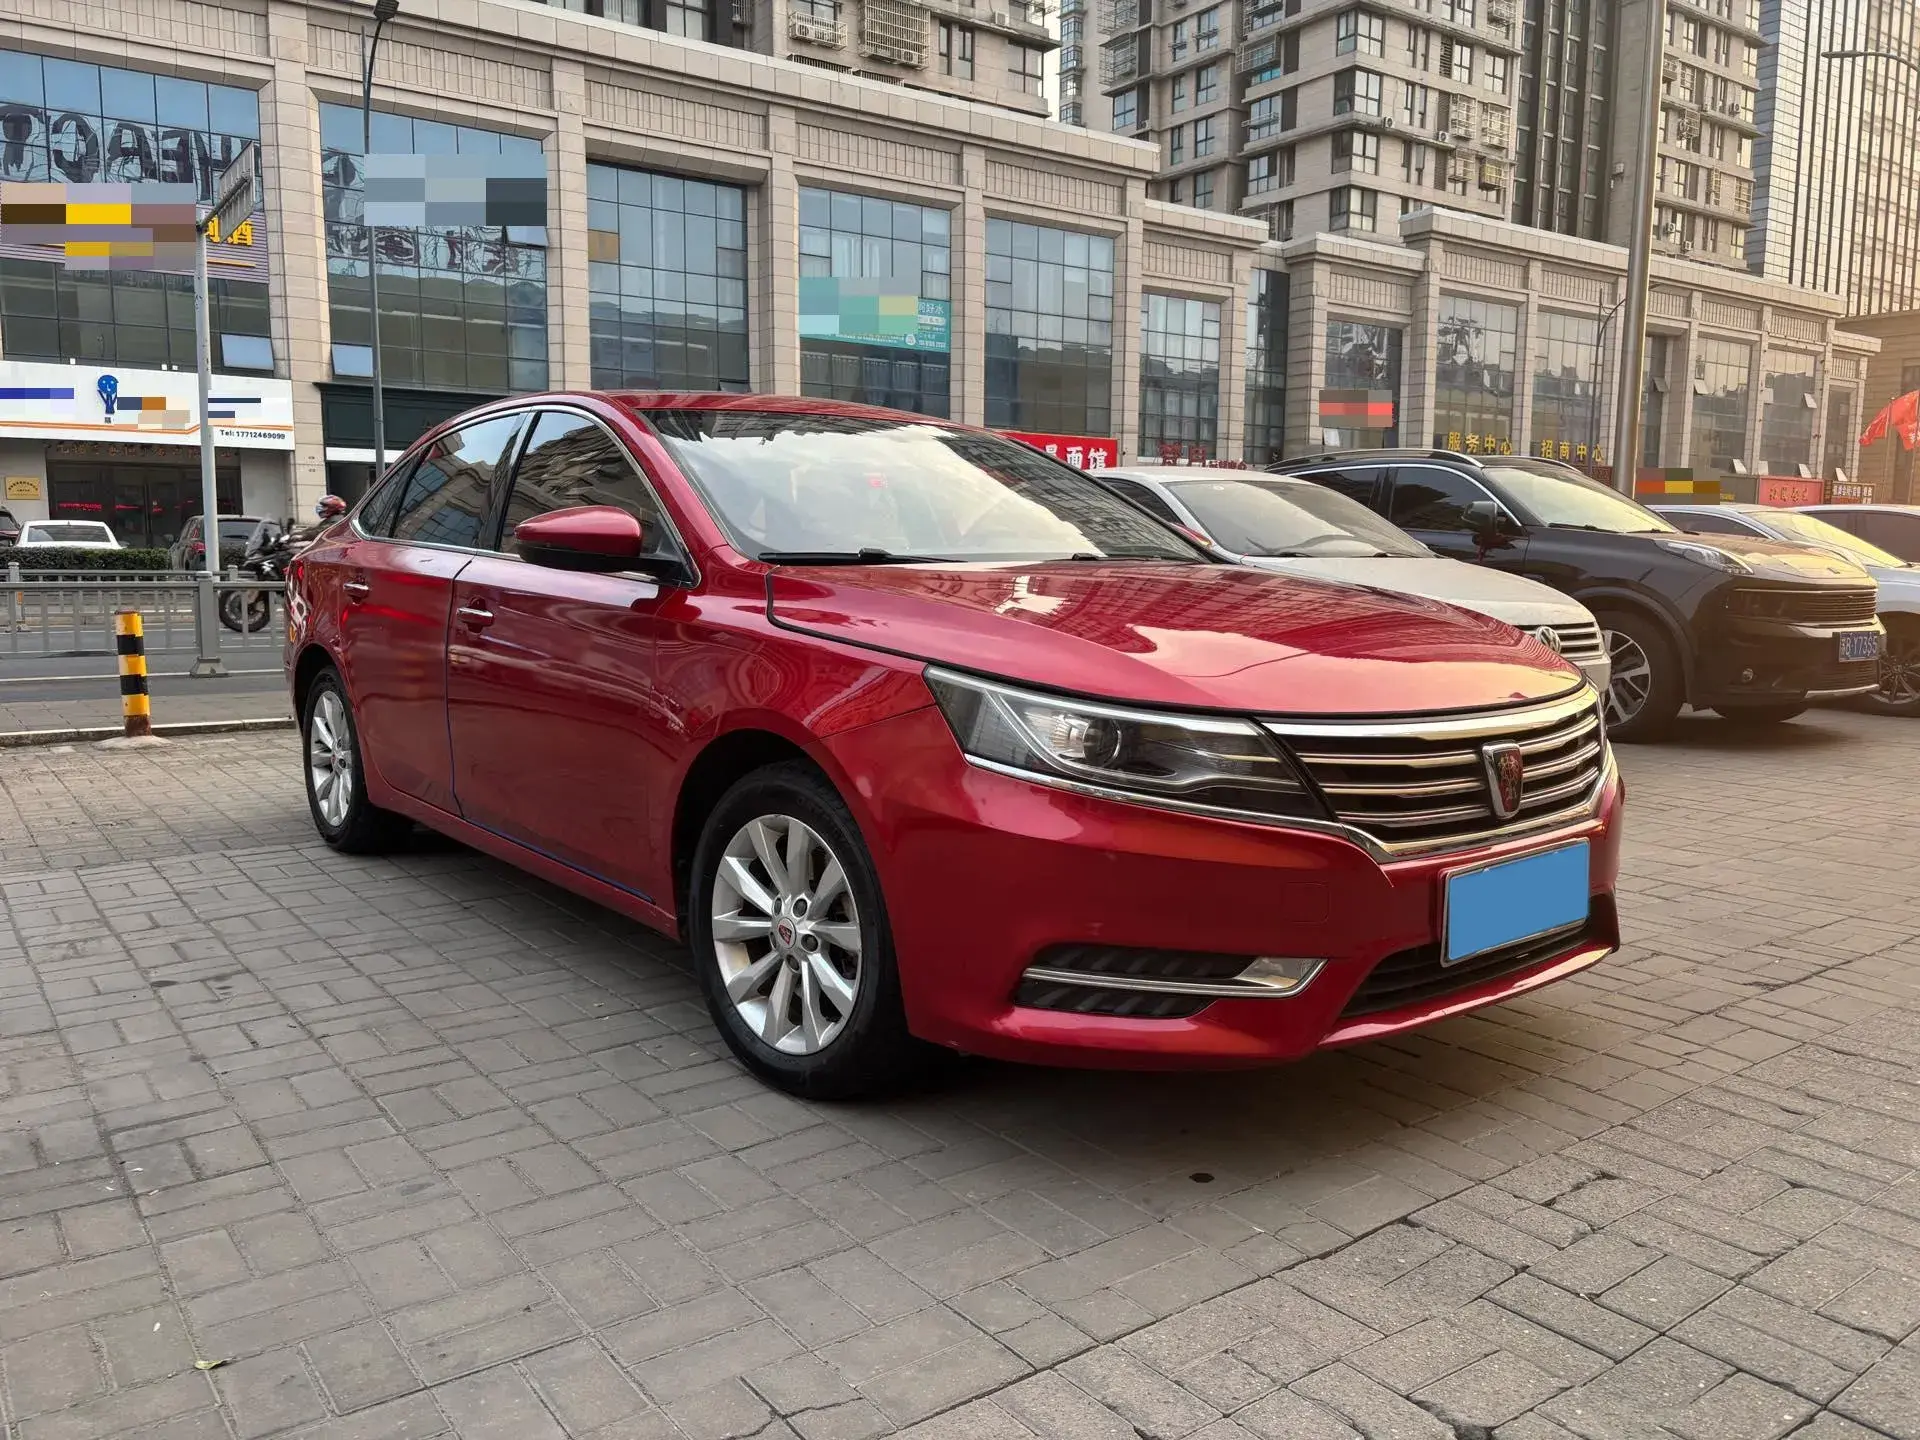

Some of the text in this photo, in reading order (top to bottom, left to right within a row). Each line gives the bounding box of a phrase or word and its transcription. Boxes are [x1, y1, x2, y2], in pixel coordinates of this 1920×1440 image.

[1447, 431, 1604, 462] 服务中心 招商中心
